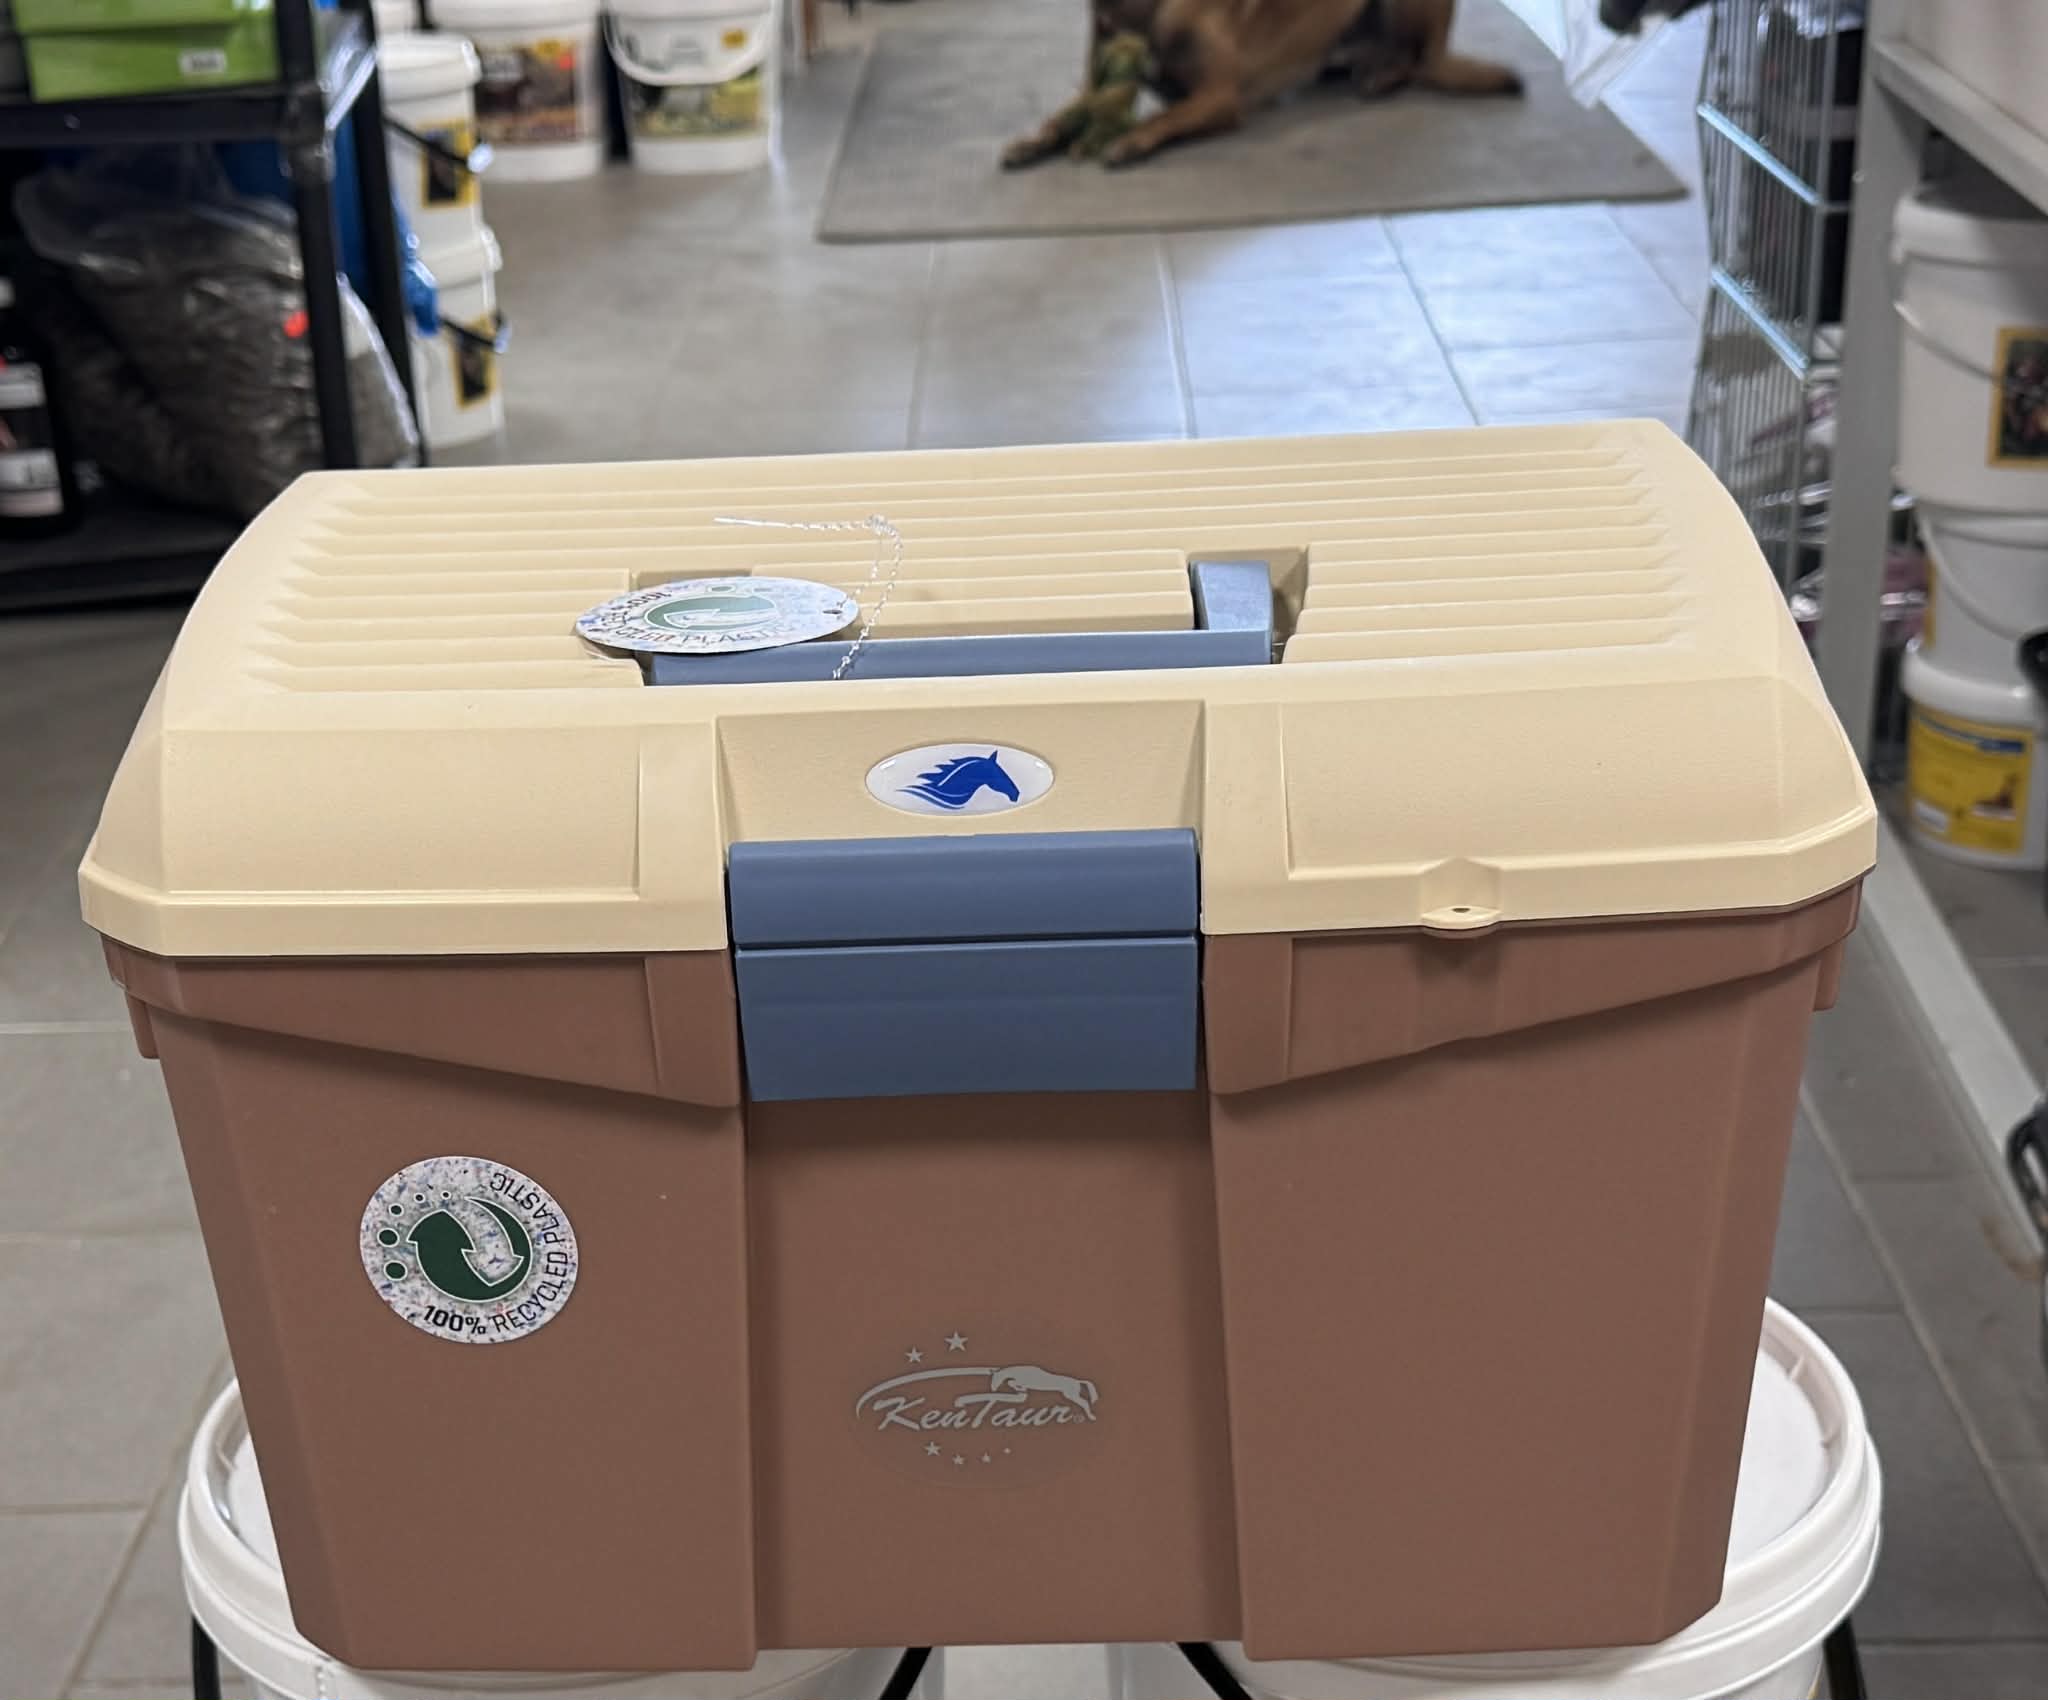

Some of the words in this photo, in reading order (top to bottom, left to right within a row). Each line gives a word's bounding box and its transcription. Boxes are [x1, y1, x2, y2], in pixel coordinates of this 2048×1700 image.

[489, 1172, 566, 1245] PLASTIC
[423, 1305, 487, 1335] 100%
[489, 1251, 569, 1333] RECYCLED
[872, 1391, 1072, 1431] KenTaur
